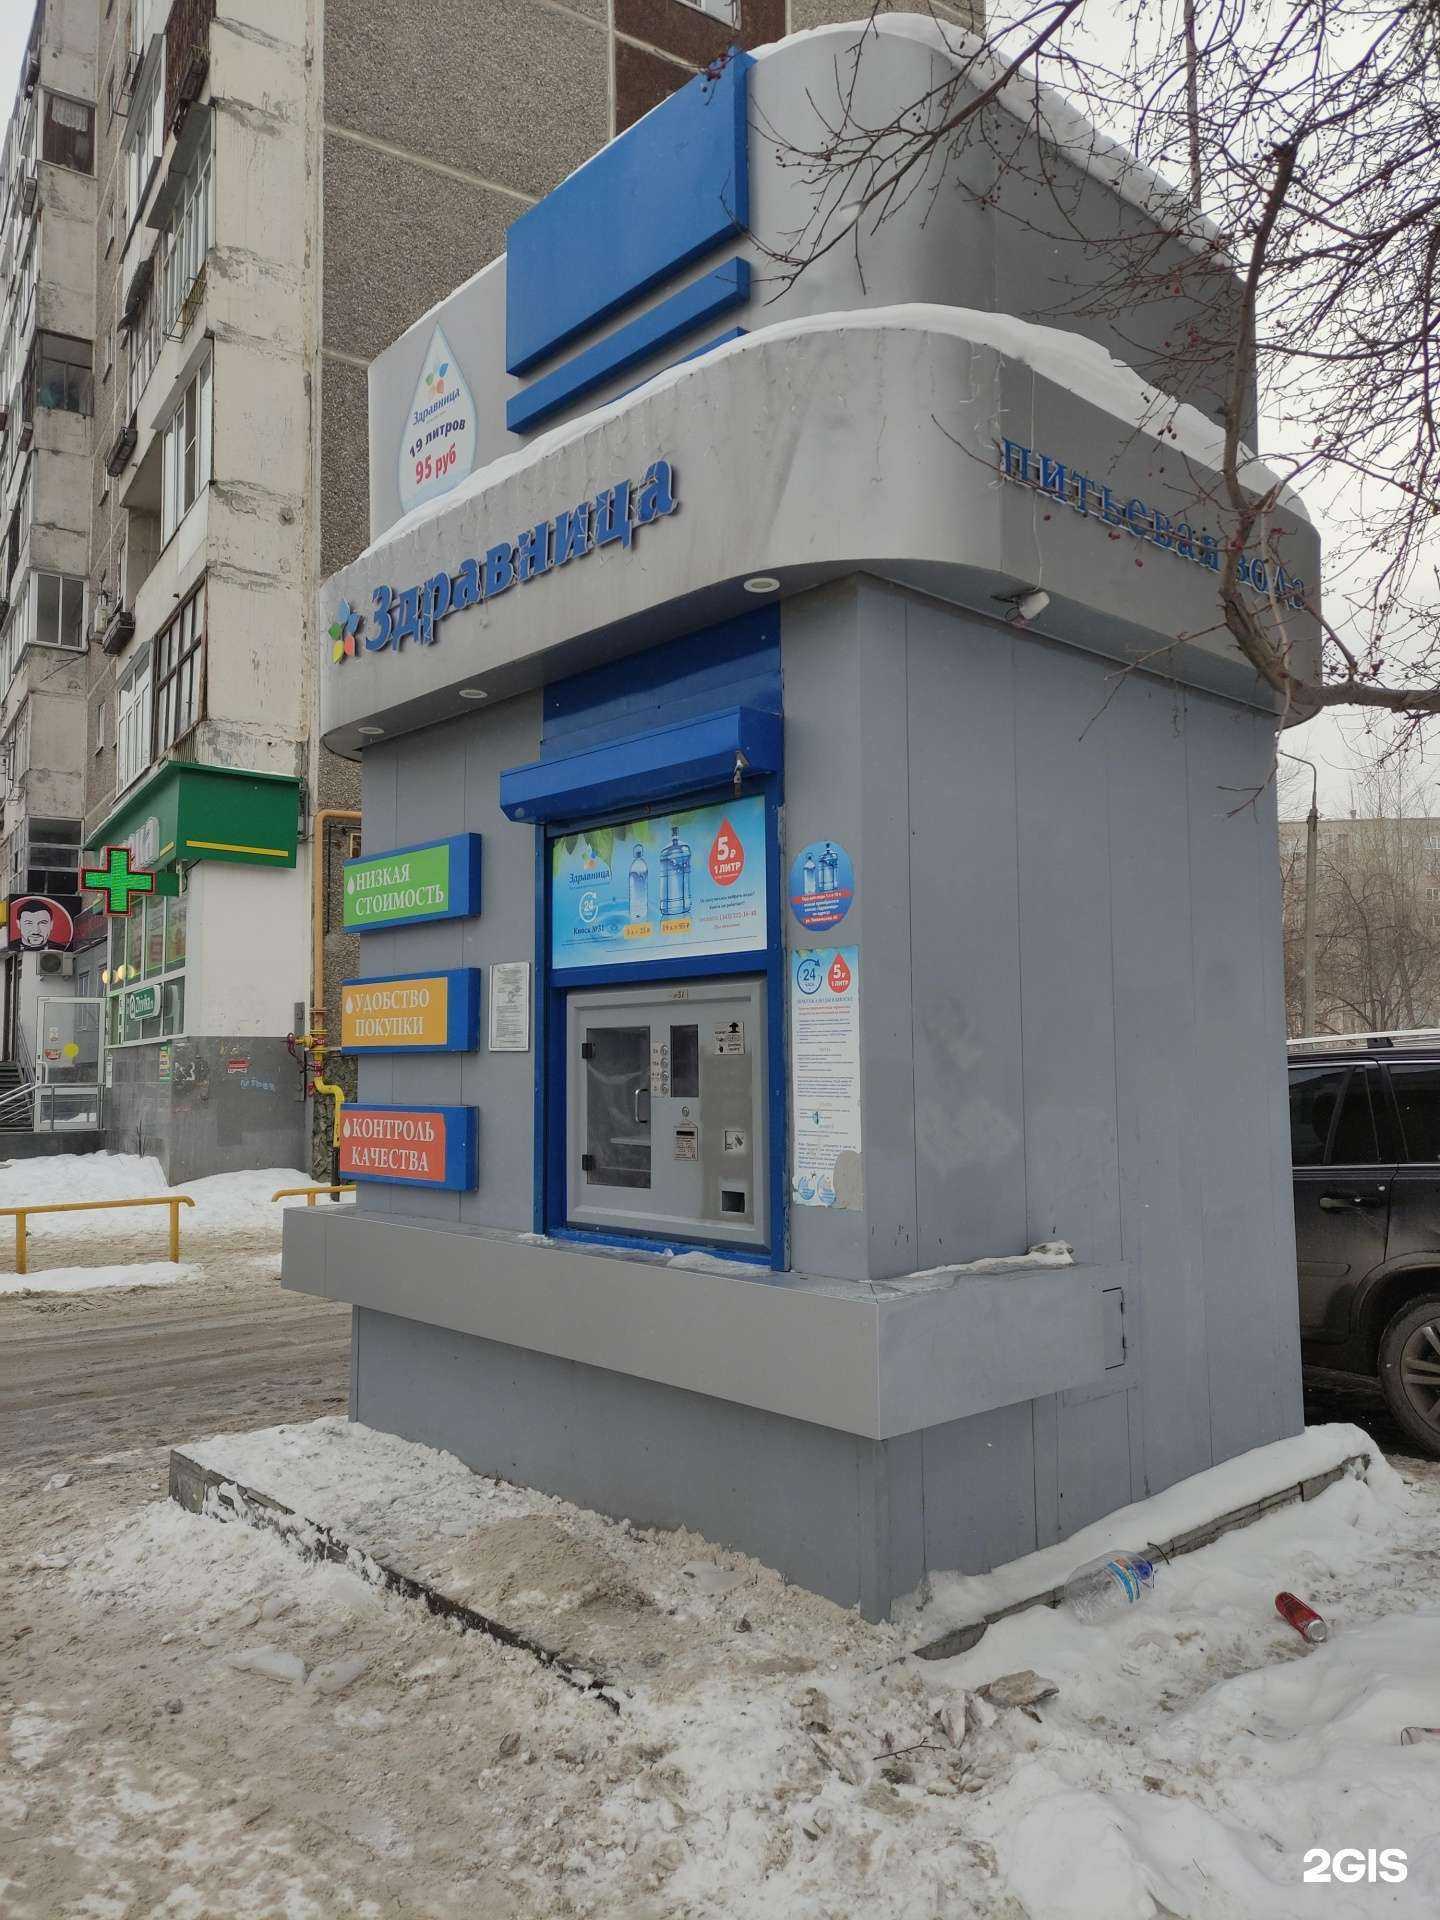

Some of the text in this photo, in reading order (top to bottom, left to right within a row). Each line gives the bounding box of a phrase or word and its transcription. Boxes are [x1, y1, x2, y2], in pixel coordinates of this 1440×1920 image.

[412, 387, 461, 426] Здравница
[408, 418, 466, 459] 19 литров
[415, 443, 458, 485] 95 руб
[365, 457, 680, 652] Здравница
[355, 863, 411, 892] НИЗКАЯ
[719, 861, 741, 873] ЛИТР
[355, 884, 444, 917] СТОИМОСТЬ
[803, 967, 816, 981] 24
[353, 987, 430, 1014] УДОБСТВО
[355, 1016, 424, 1038] ПОКУПКИ
[352, 1118, 435, 1143] КОНТРОЛЬ
[352, 1145, 430, 1172] КАЧЕСТВА
